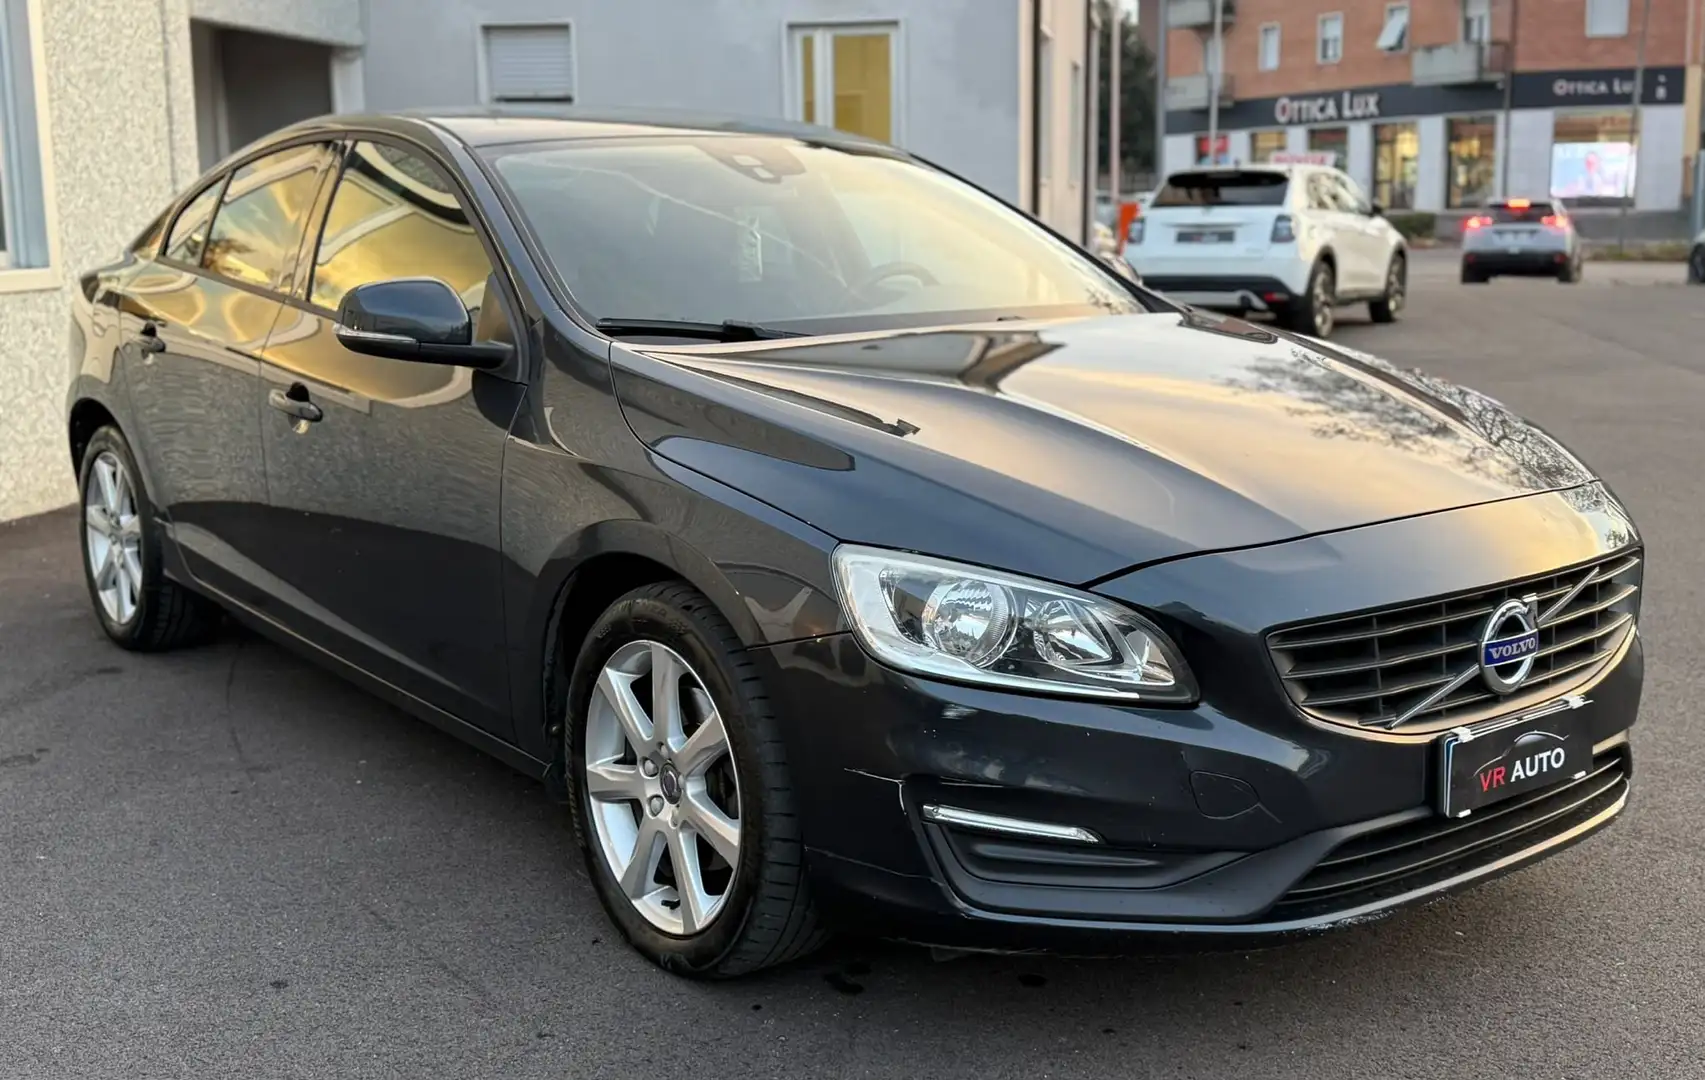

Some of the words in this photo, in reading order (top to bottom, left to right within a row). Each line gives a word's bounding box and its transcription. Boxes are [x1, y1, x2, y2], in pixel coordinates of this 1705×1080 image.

[1612, 77, 1642, 95] LU
[1274, 96, 1338, 124] OTTICA
[1341, 90, 1380, 118] LUX
[1488, 637, 1536, 660] VOLVO
[1479, 766, 1506, 793] VR
[1510, 747, 1565, 783] AUTO
